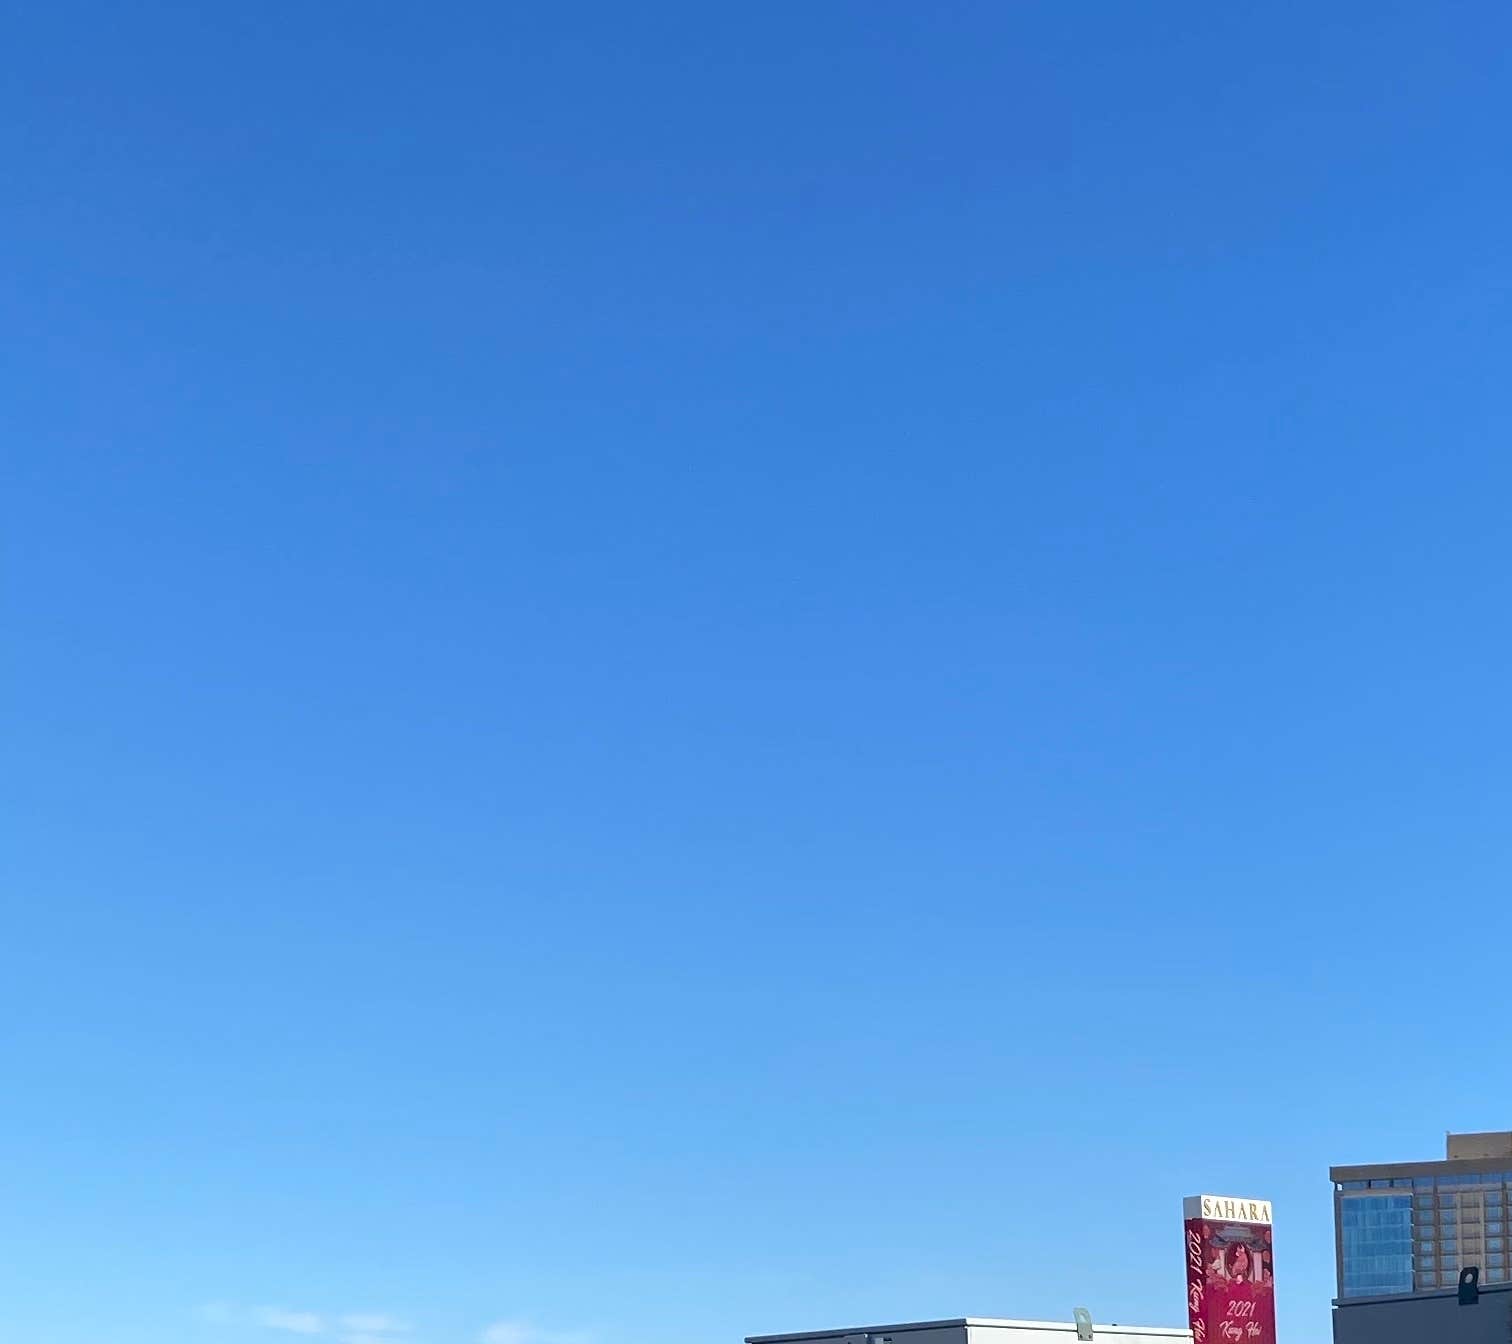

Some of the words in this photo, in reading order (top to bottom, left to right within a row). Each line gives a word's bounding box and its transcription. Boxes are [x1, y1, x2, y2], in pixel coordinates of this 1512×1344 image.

[1203, 1198, 1270, 1222] SAHARA
[1188, 1229, 1203, 1275] 2021
[1189, 1279, 1204, 1313] Kung
[1226, 1300, 1257, 1317] 2021
[1219, 1320, 1243, 1341] Kung
